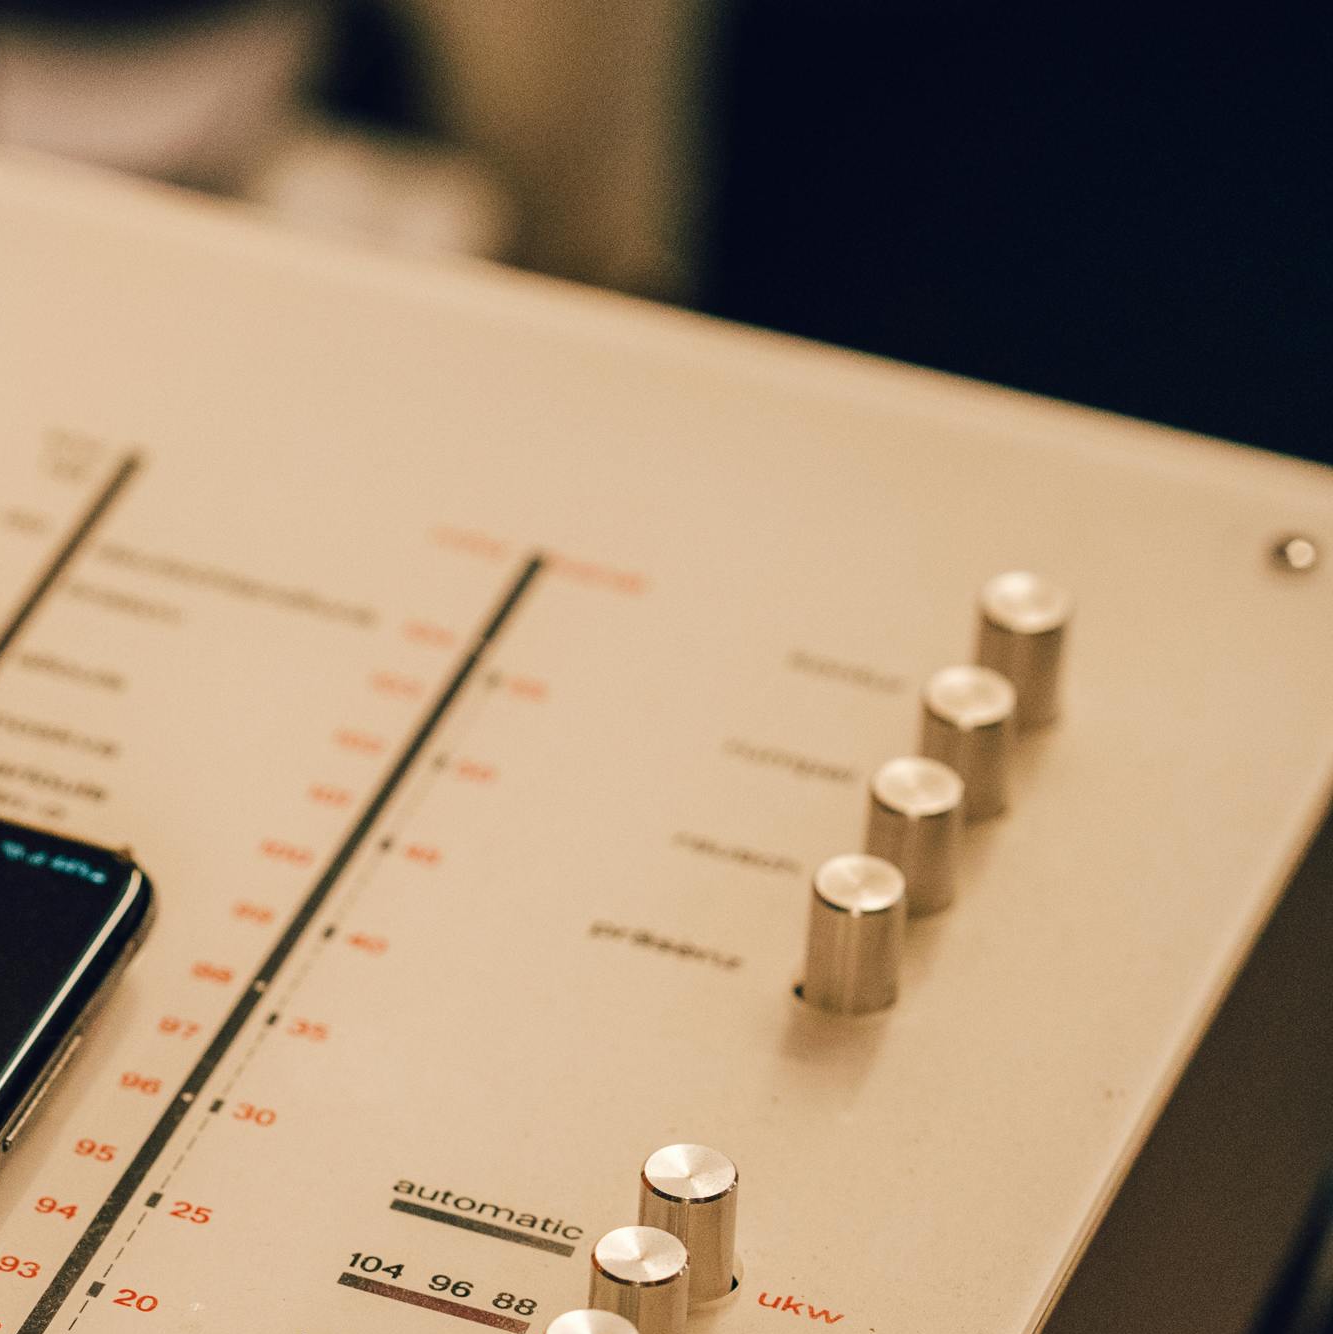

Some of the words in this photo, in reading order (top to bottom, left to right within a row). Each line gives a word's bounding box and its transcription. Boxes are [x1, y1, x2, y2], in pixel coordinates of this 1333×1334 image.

[119, 1071, 163, 1097] 96
[233, 1103, 277, 1128] 30
[73, 1139, 117, 1163] 95
[34, 1197, 79, 1221] 94
[169, 1201, 213, 1225] 25
[392, 1176, 584, 1243] automatic
[348, 1251, 406, 1280] 104
[428, 1273, 474, 1299] 96
[491, 1291, 538, 1317] 88
[112, 1289, 159, 1313] 20
[757, 1291, 844, 1325] ukw
